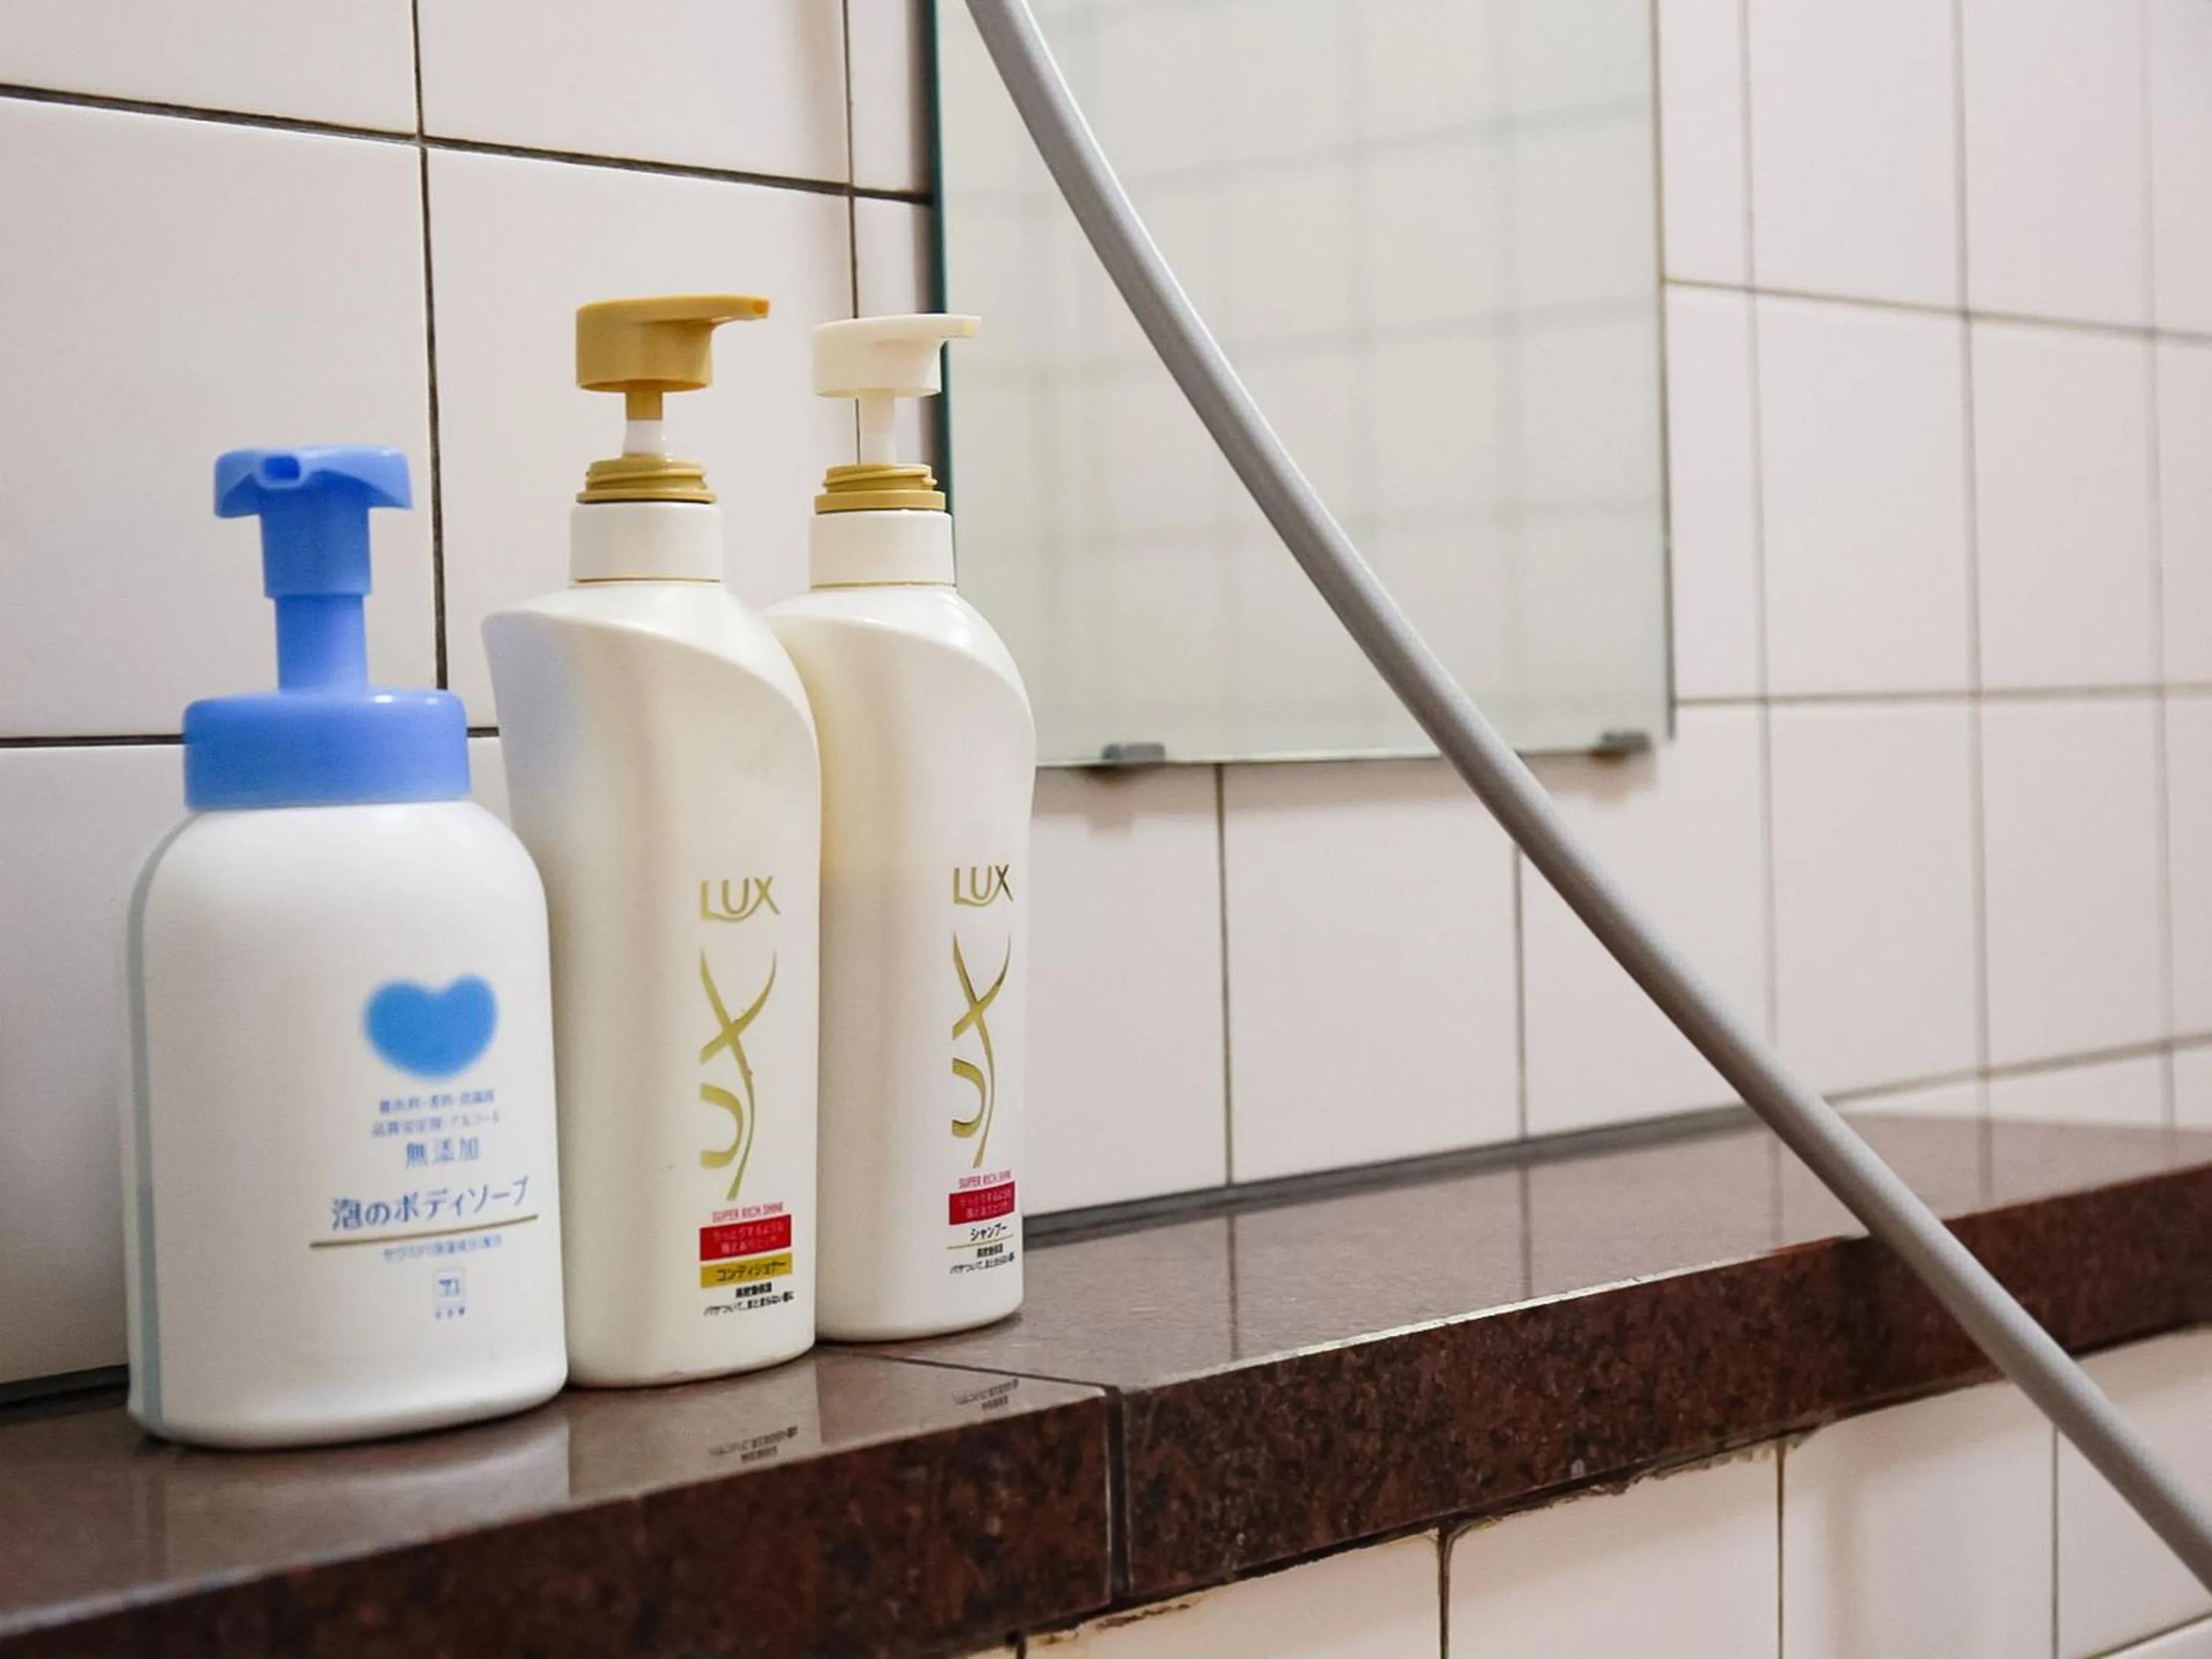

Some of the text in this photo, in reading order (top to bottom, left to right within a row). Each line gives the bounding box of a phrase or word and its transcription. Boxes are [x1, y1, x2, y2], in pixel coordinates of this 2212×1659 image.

[700, 875, 780, 922] LUX
[952, 864, 1013, 908] LUX
[406, 1137, 479, 1168] 無添加
[331, 1174, 529, 1230] 泡のボディソープ
[970, 1223, 1008, 1241] シャンプー
